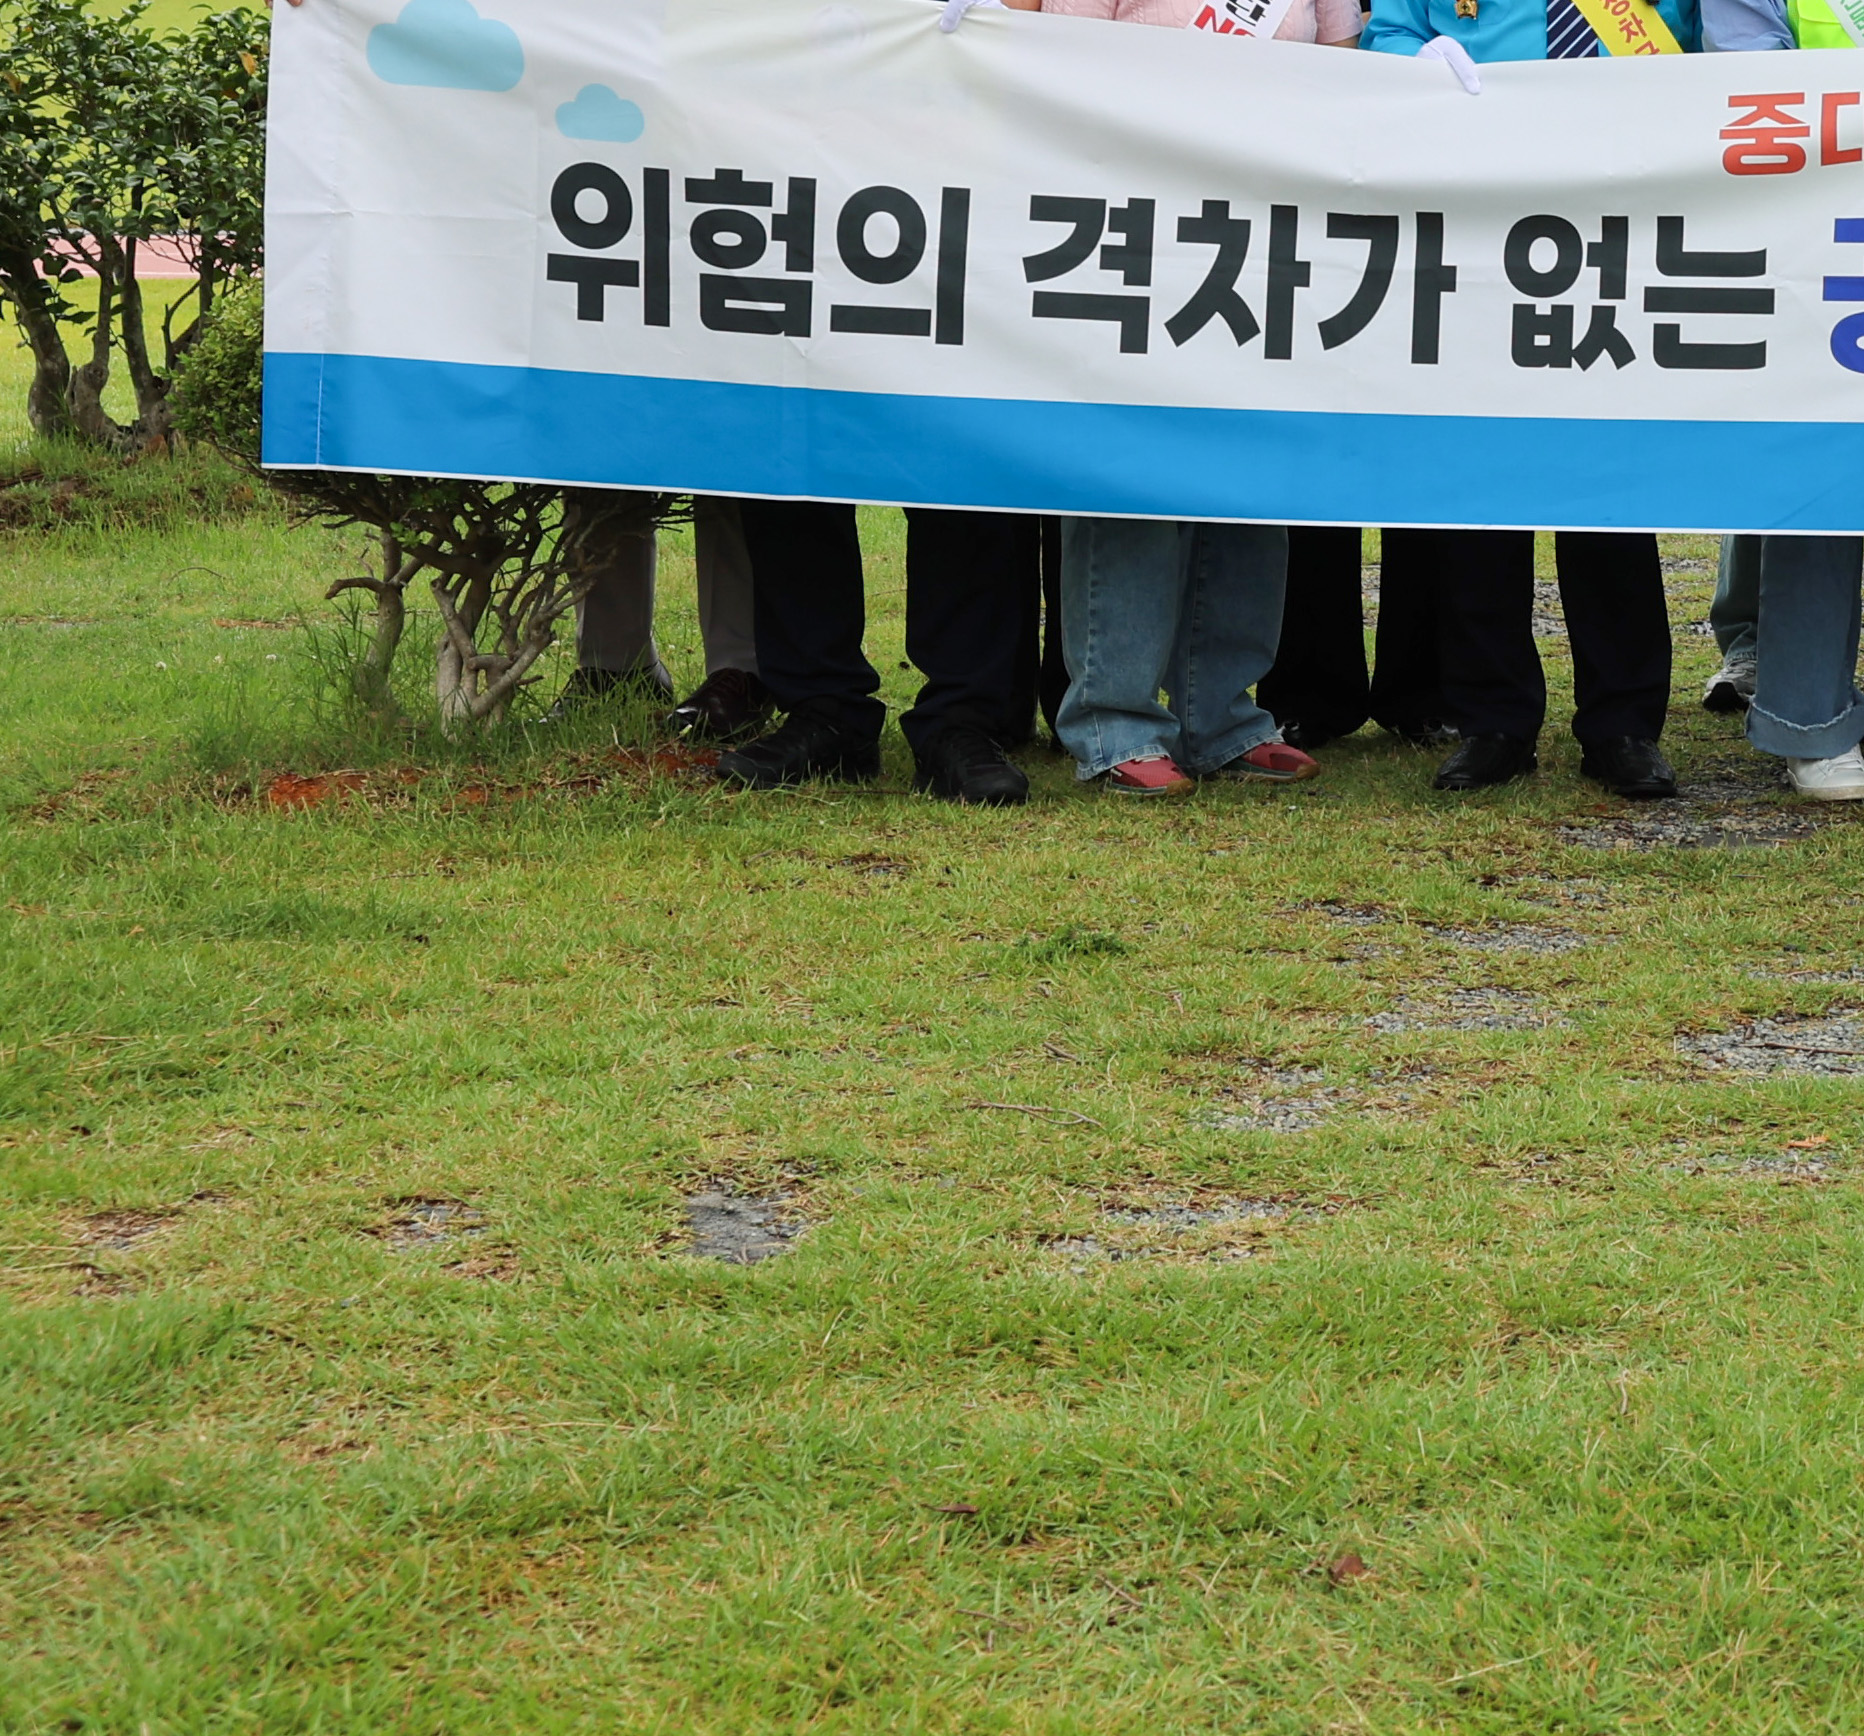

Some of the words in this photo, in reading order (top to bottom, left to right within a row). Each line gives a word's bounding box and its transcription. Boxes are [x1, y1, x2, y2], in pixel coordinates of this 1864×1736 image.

[547, 162, 970, 346] 위험의
[1023, 196, 1457, 365] 격차가
[1504, 215, 1775, 371] 없는
